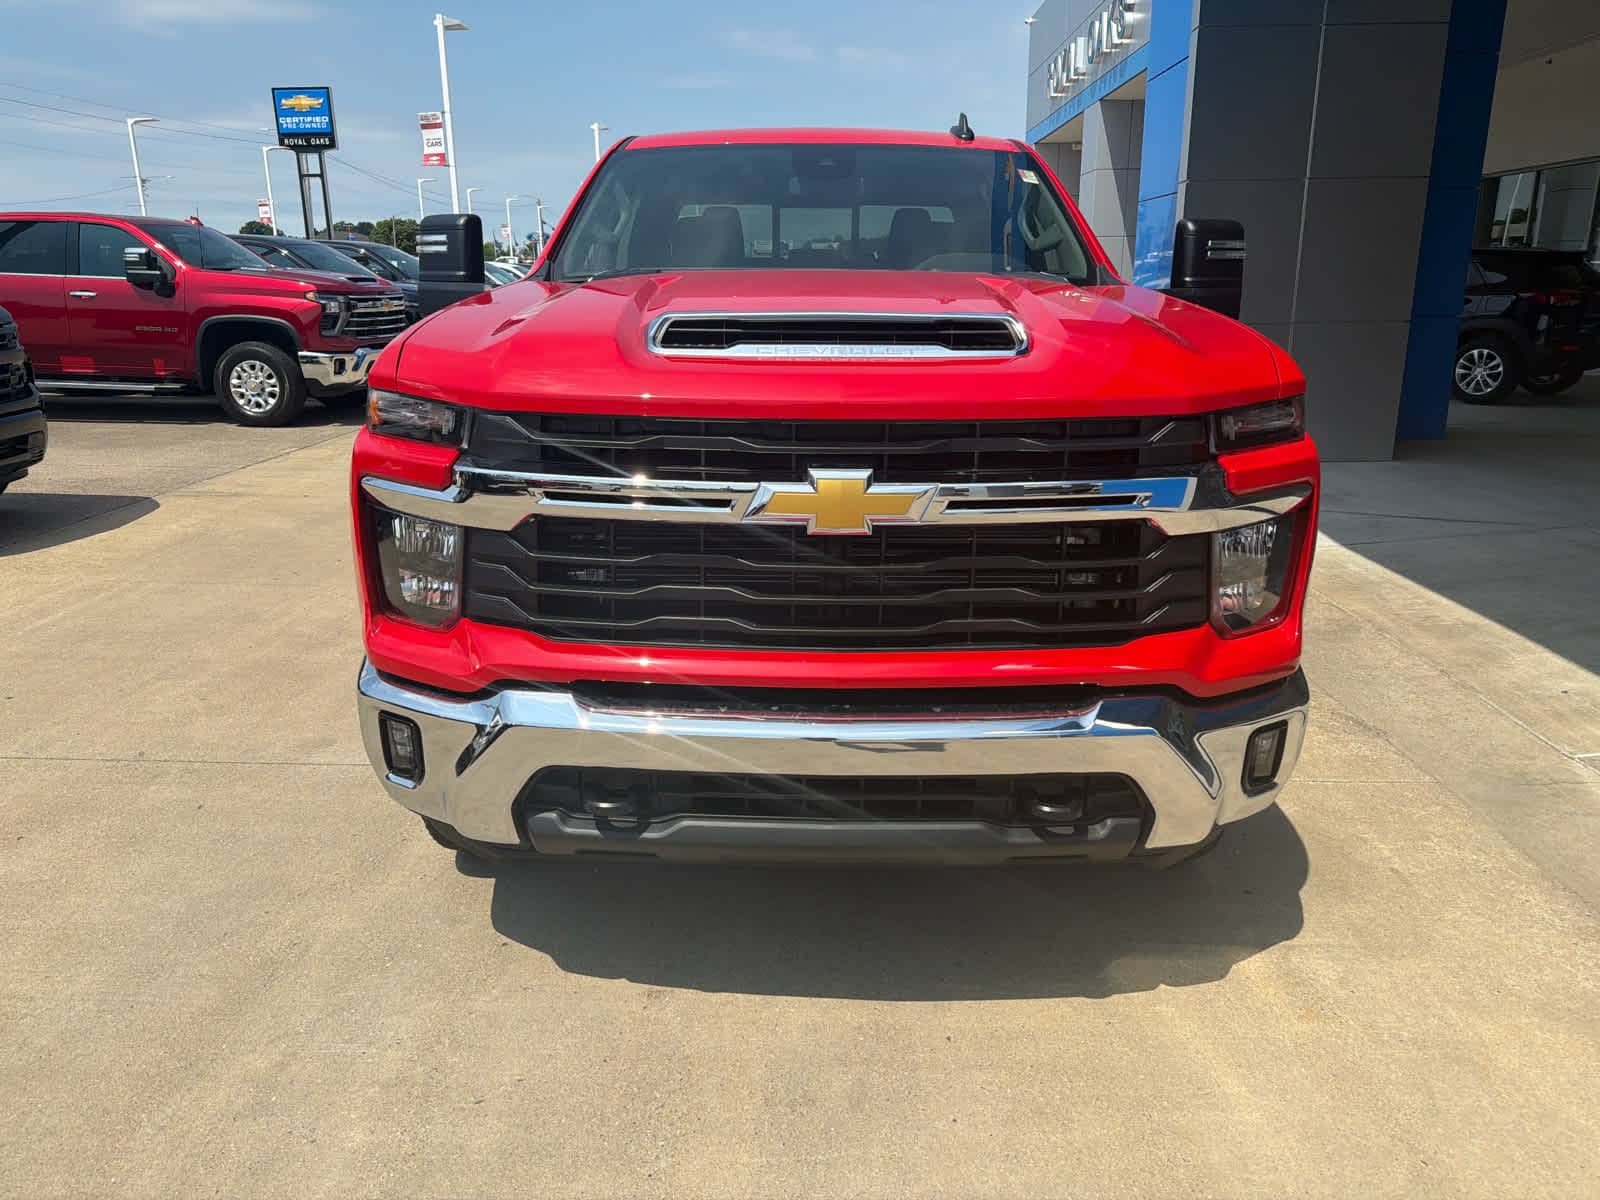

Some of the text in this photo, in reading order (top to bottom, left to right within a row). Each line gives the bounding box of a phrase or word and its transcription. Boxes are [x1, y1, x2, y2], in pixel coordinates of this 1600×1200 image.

[284, 137, 330, 146] ROYAL OAKS
[425, 140, 443, 148] CARS
[755, 346, 920, 356] CHEVROLET
